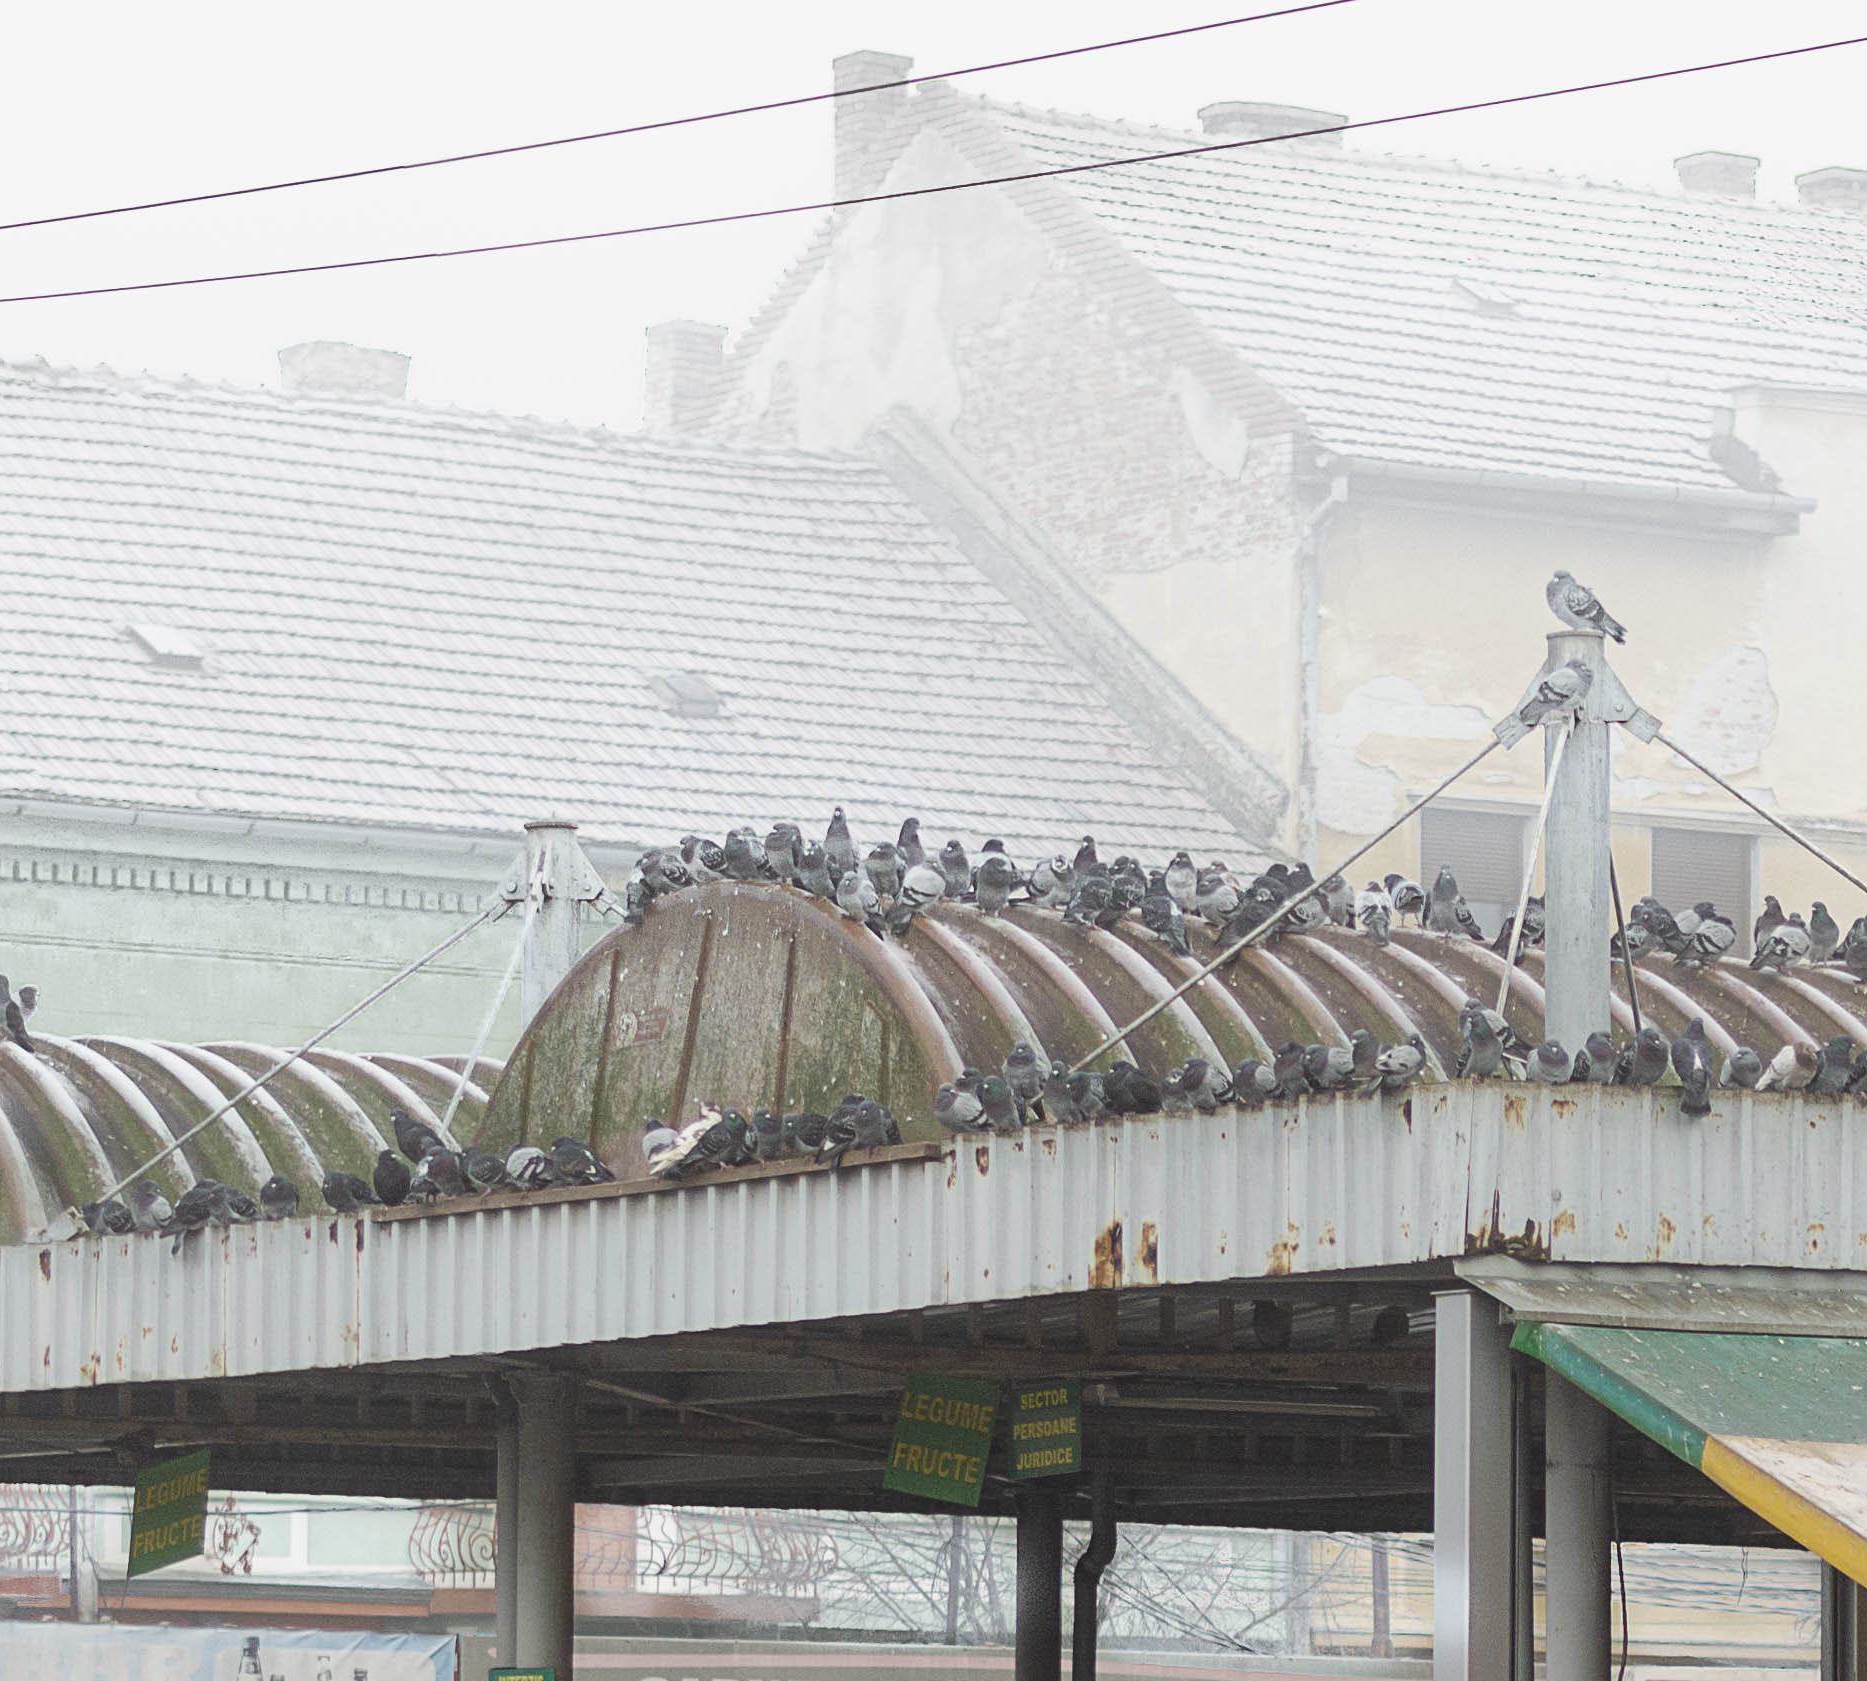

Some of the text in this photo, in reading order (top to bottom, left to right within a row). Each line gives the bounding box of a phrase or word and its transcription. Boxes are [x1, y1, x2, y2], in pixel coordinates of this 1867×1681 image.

[902, 1392, 994, 1432] LEGUME
[1020, 1388, 1068, 1410] SECTOR
[892, 1442, 980, 1483] FRUCTE
[1017, 1448, 1073, 1470] JURIDICE
[136, 1468, 208, 1513] LEGUME
[134, 1515, 200, 1559] FRUCTE
